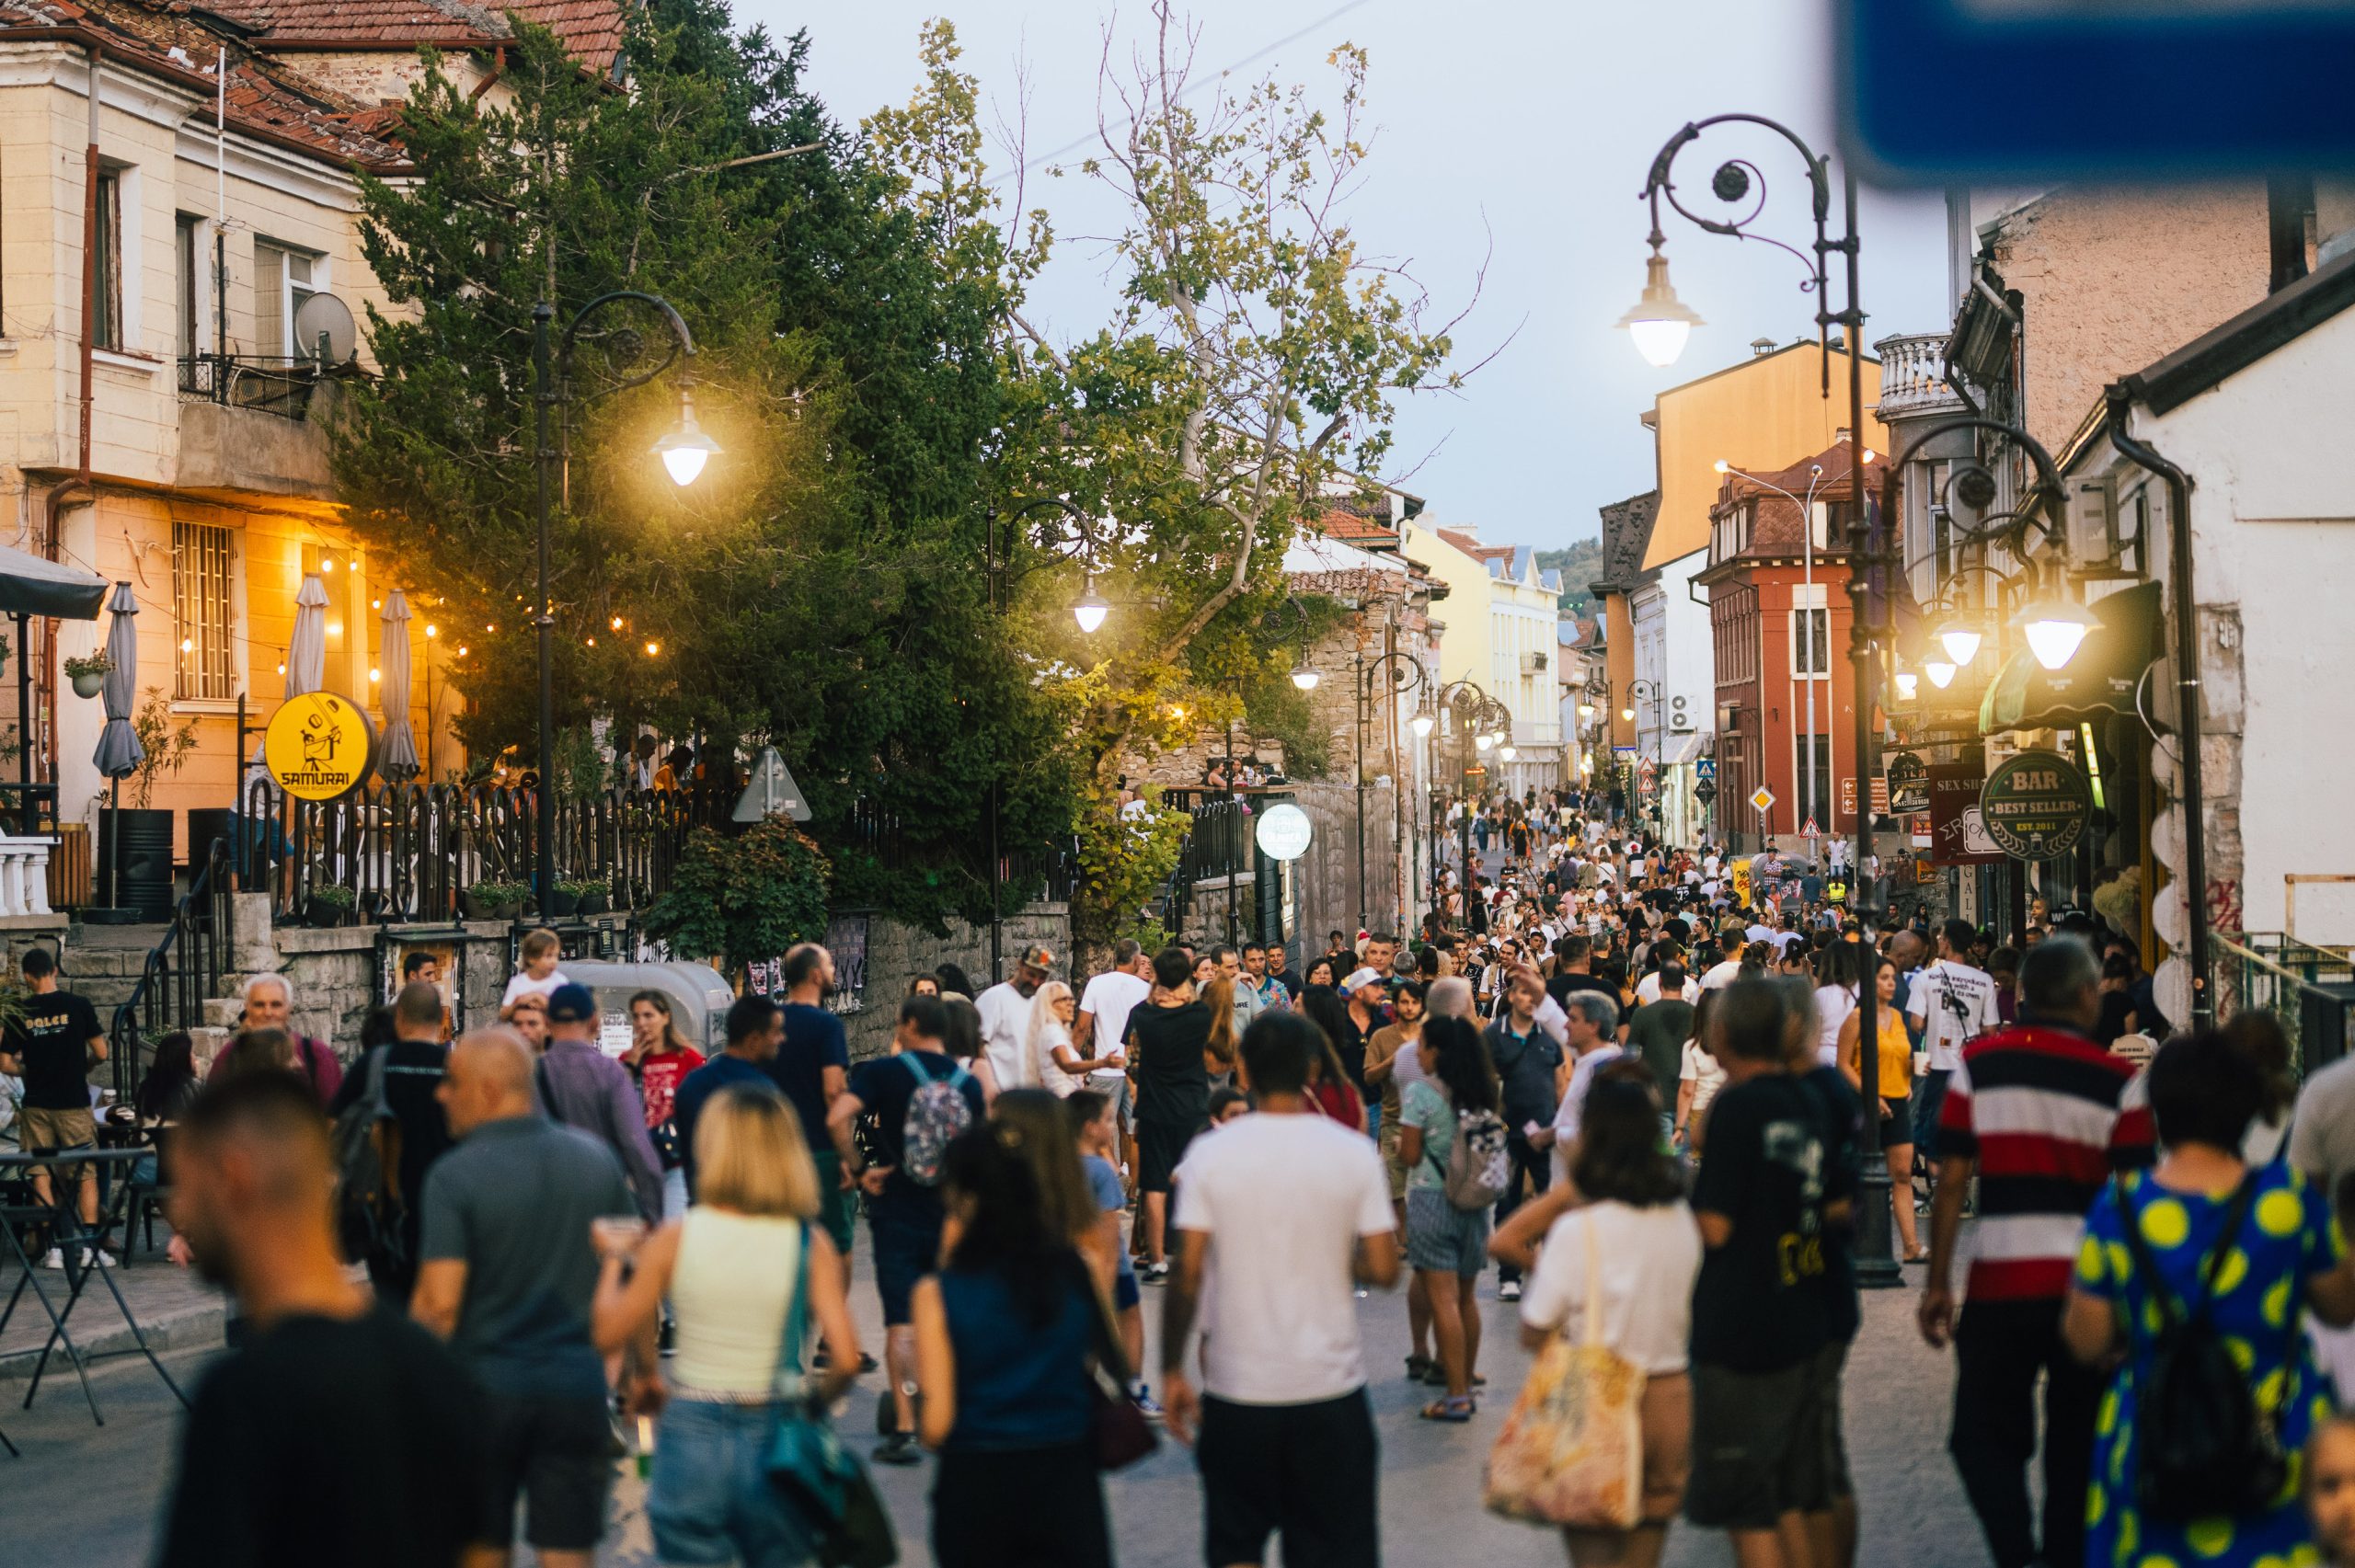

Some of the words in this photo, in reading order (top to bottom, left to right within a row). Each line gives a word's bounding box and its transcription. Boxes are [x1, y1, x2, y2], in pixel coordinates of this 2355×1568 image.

[281, 773, 349, 785] SAMURAI
[2013, 771, 2059, 790] BAR
[1936, 780, 1960, 792] SEX
[1994, 803, 2027, 814] BEST
[2029, 801, 2076, 813] SELLER
[2035, 822, 2056, 830] 2011
[26, 1013, 69, 1030] DOLCE
